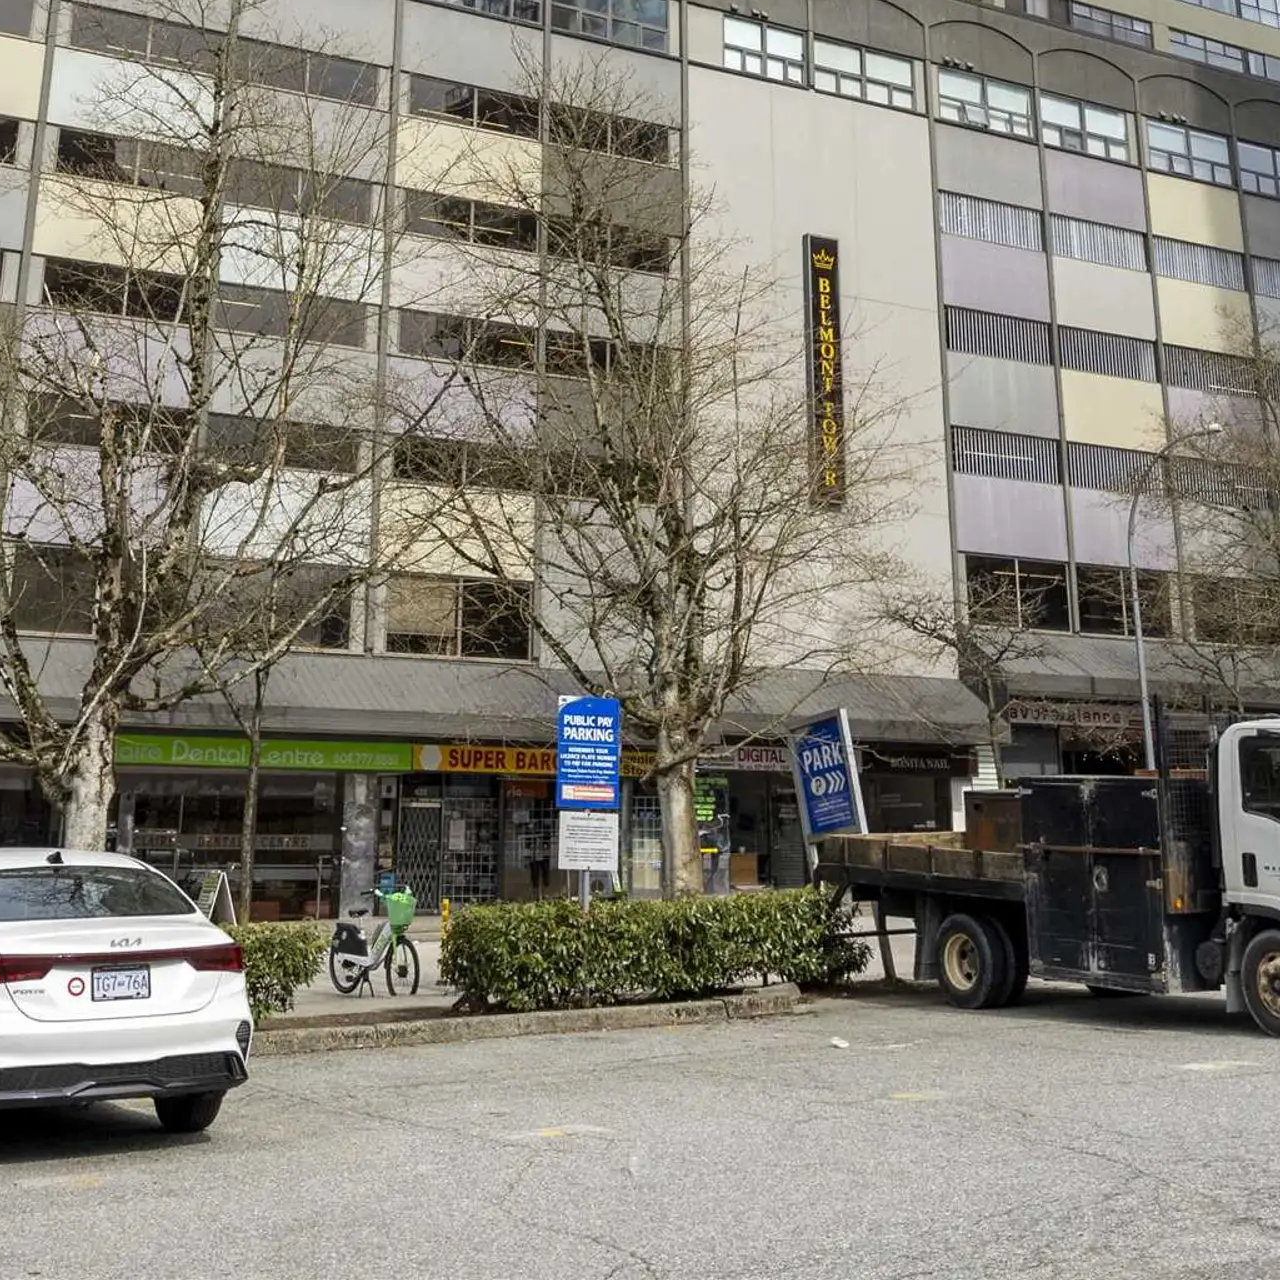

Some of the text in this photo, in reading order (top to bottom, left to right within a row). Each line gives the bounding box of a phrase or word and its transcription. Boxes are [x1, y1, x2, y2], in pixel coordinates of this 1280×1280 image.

[818, 277, 835, 393] BELMONT
[563, 714, 613, 728] PUBLIC PAY
[563, 727, 614, 742] PARKING
[171, 740, 246, 763] Dental
[448, 748, 506, 769] SUPER
[738, 747, 786, 764] DIGITAL
[802, 741, 844, 774] PARK
